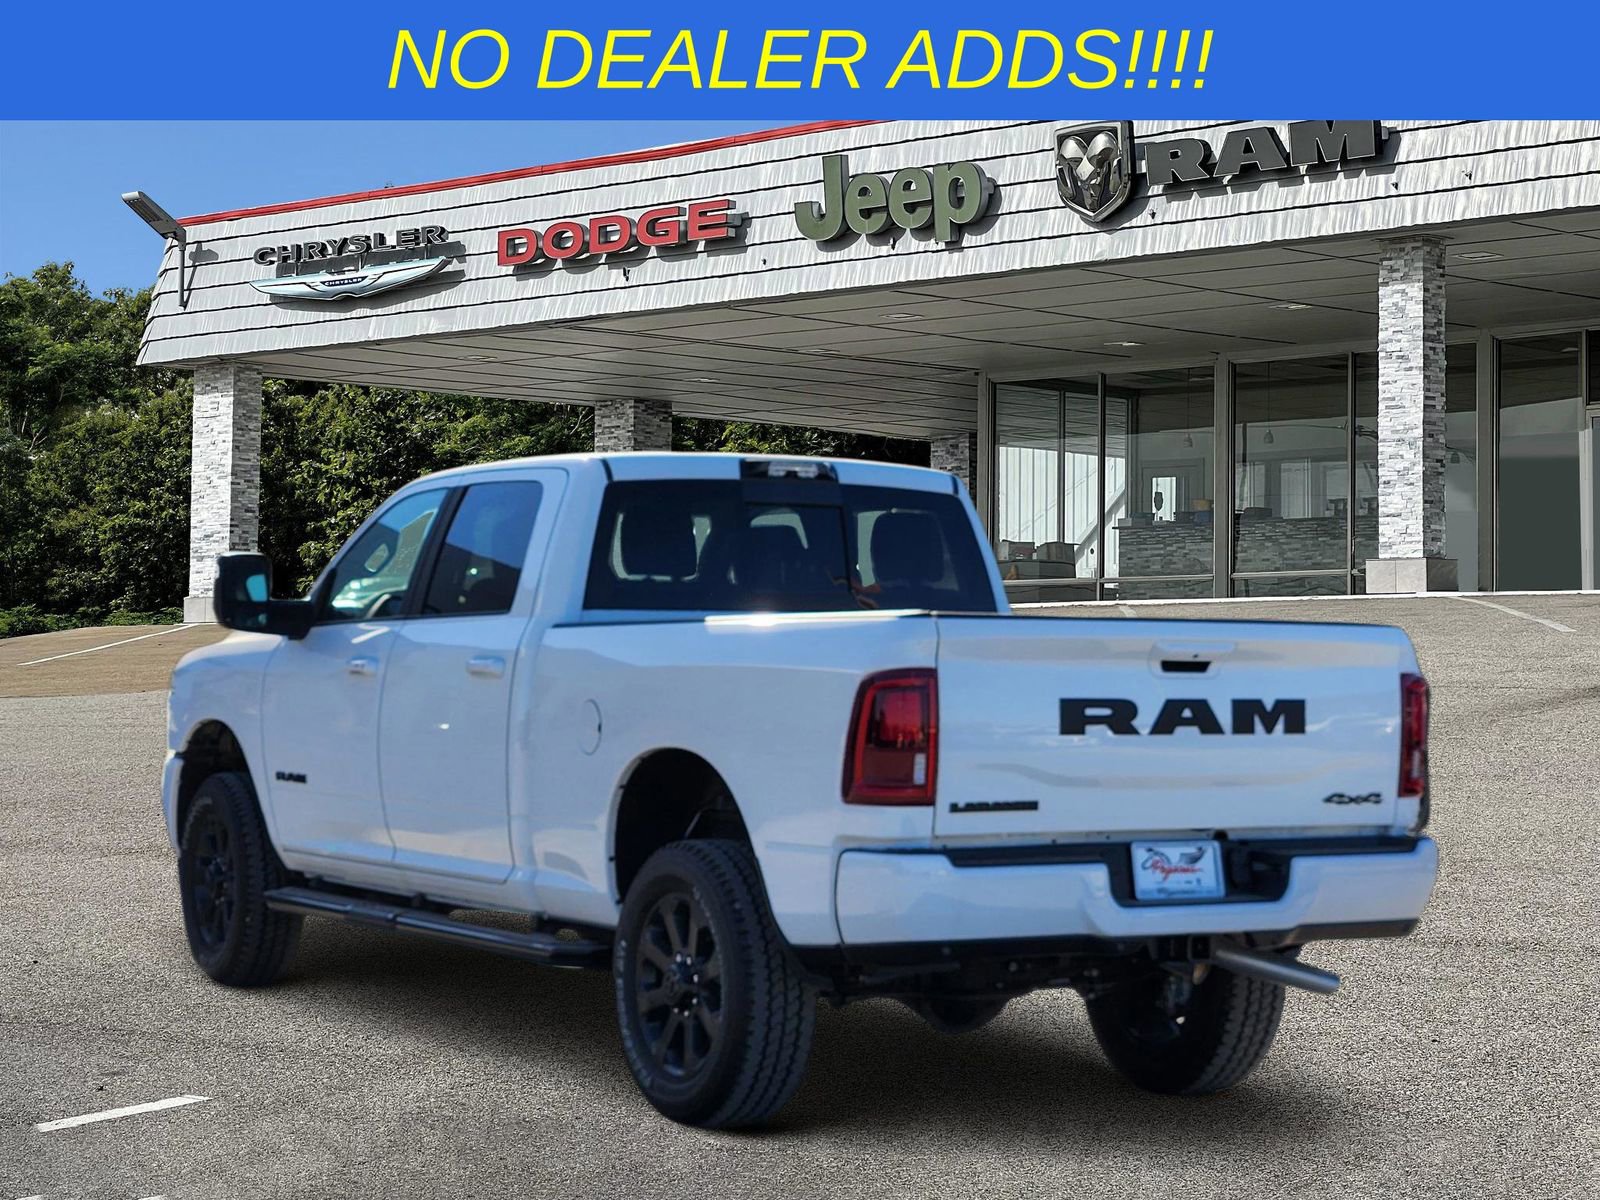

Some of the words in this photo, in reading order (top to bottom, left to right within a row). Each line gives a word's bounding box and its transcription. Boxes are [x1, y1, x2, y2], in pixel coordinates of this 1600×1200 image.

[1146, 119, 1382, 186] RAM
[794, 154, 992, 243] Jeep
[253, 225, 447, 266] CHRYSLER
[497, 199, 738, 267] DODGE
[324, 277, 363, 286] CHRYSLER
[1059, 698, 1306, 736] RAM
